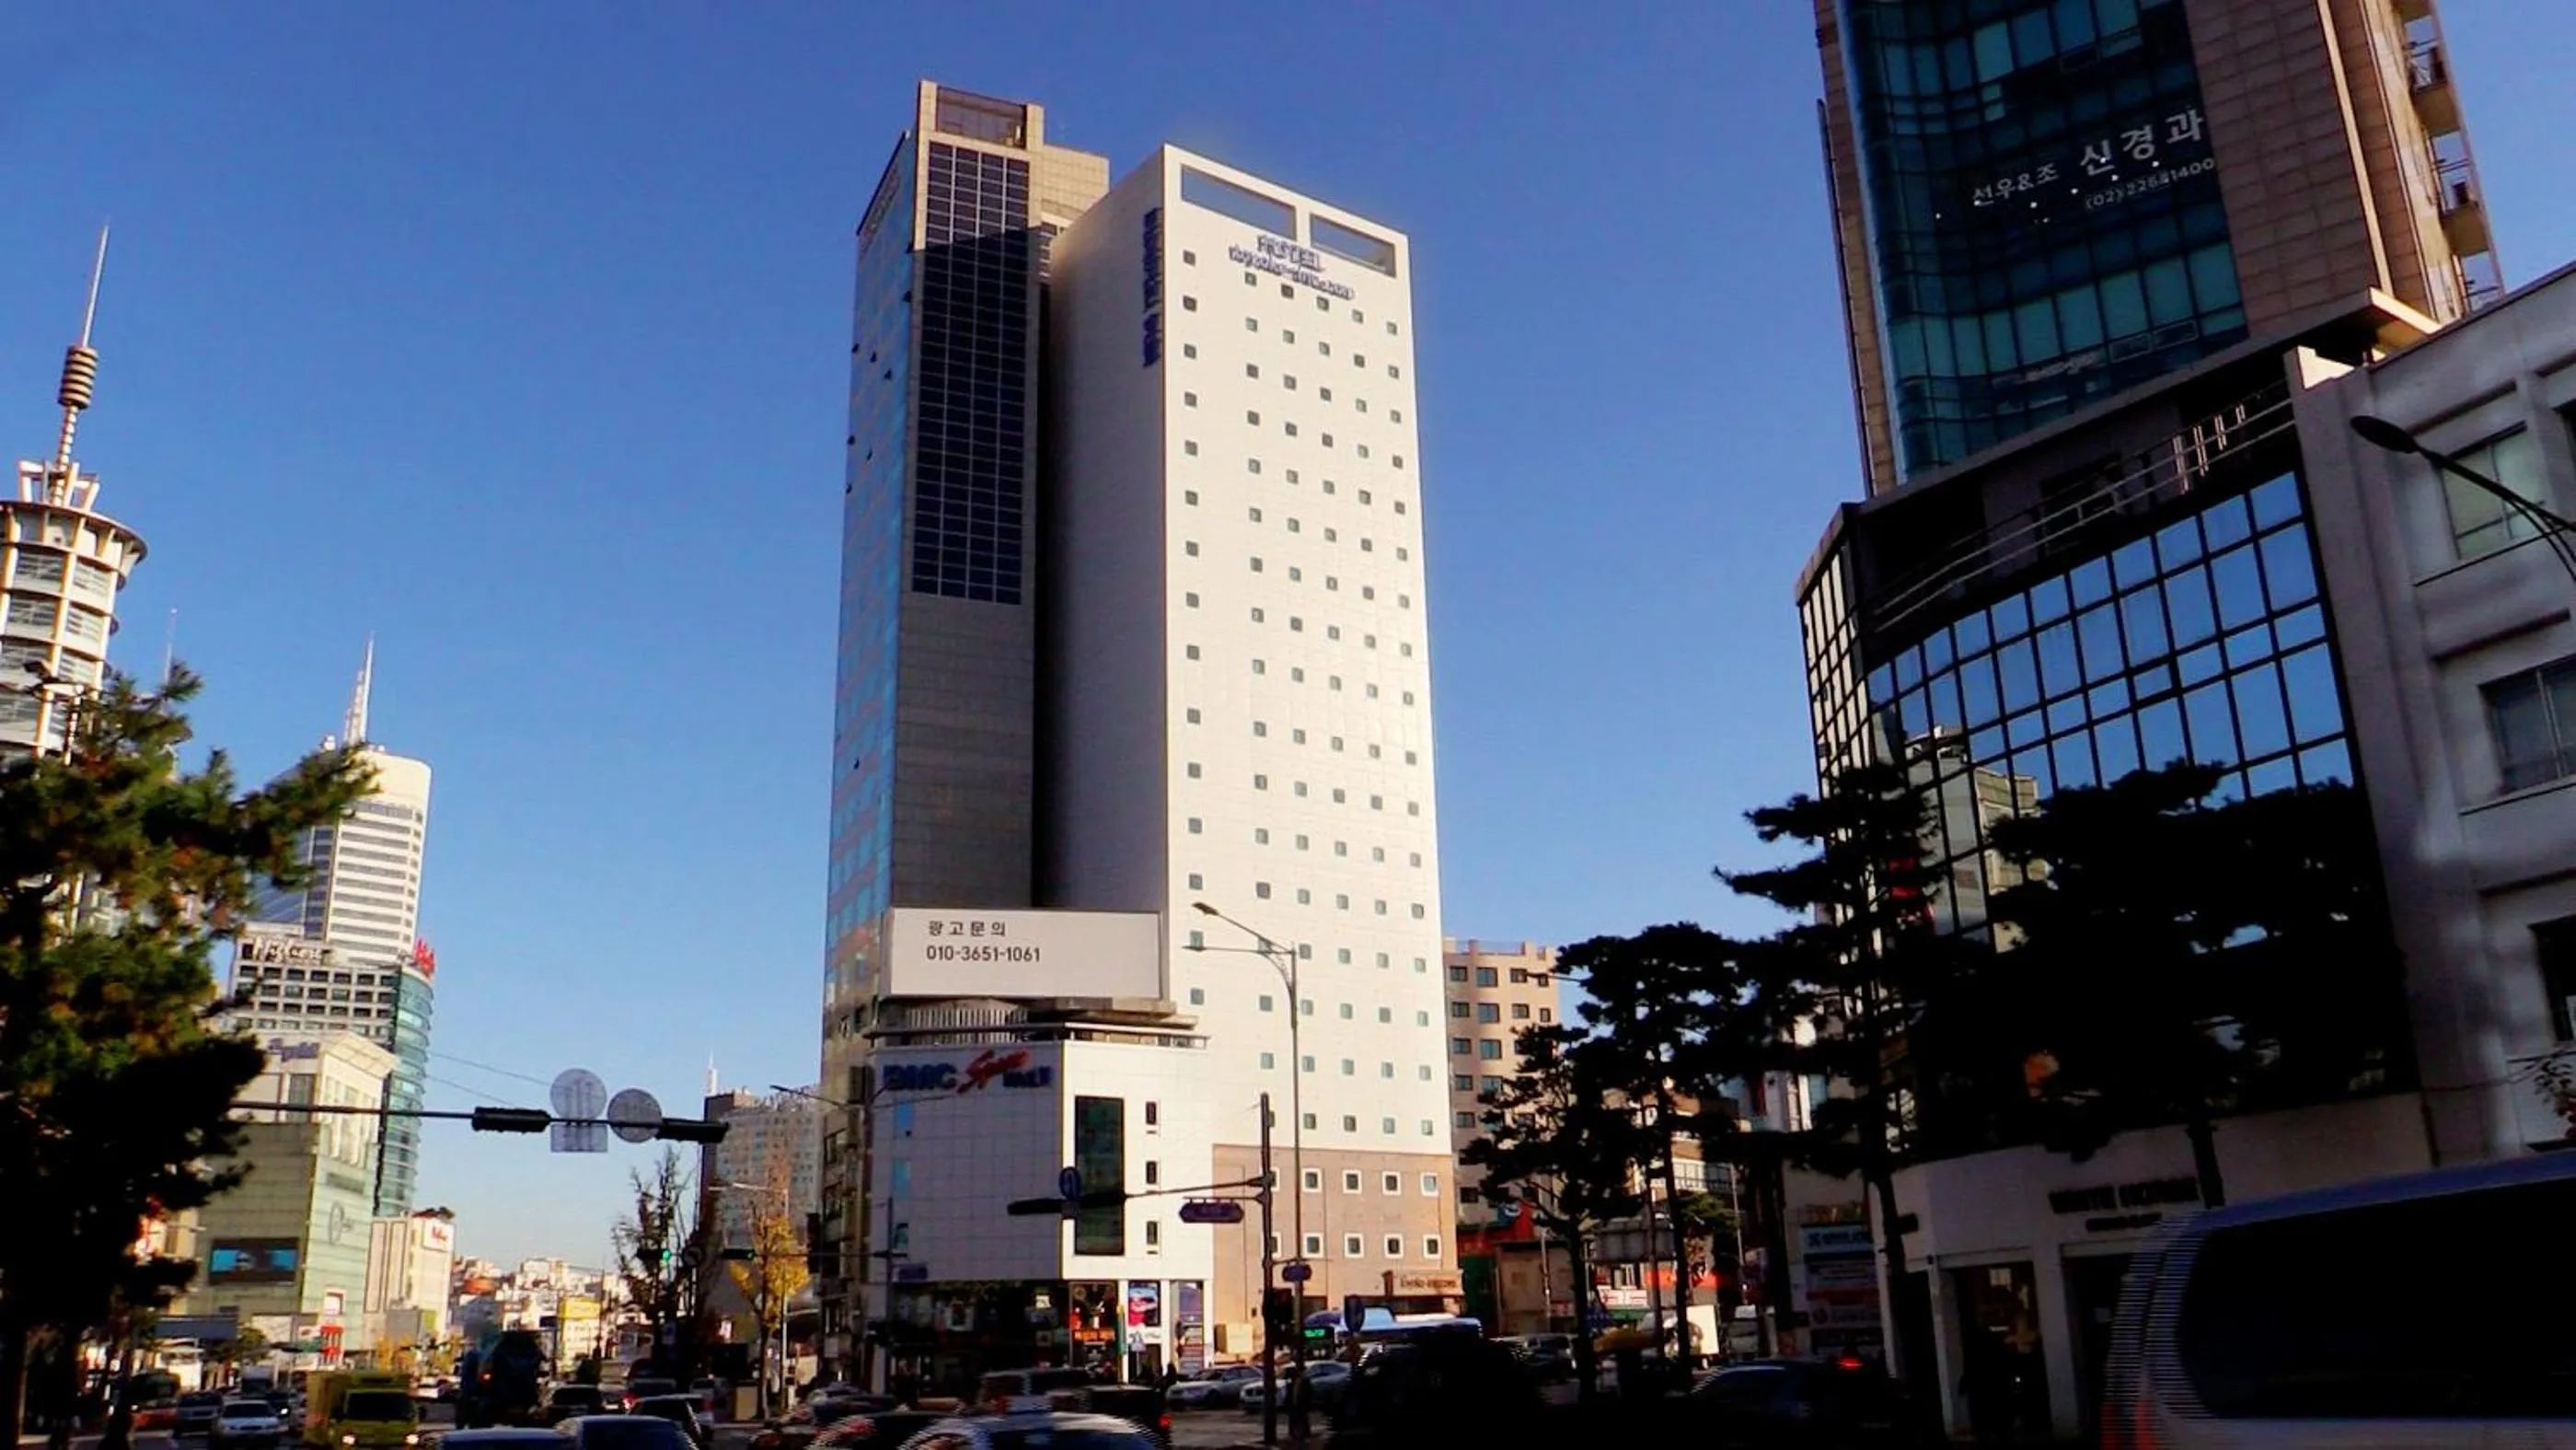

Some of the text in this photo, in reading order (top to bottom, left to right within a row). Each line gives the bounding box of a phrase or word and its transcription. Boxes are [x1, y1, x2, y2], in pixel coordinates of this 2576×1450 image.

[2079, 108, 2205, 176] 신경과
[928, 921, 1006, 937] 광고문의
[926, 945, 1041, 963] 010-3651-1061
